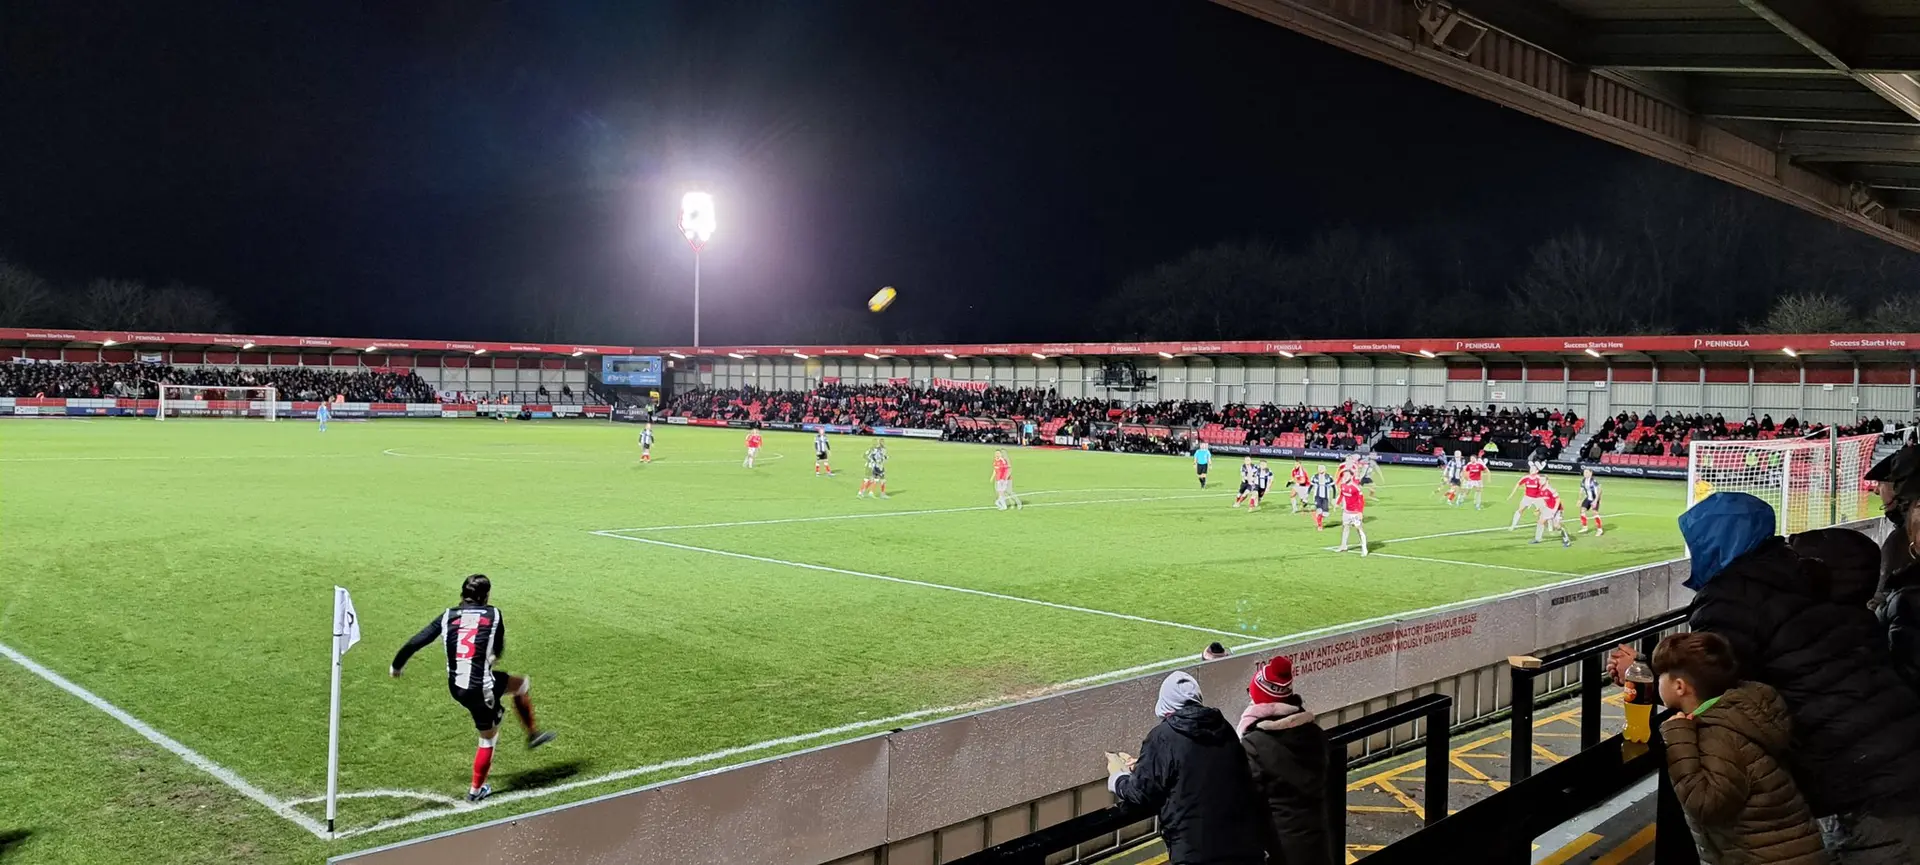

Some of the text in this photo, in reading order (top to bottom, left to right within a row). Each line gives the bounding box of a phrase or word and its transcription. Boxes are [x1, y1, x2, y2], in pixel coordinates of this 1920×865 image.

[456, 628, 478, 658] 3
[1300, 649, 1316, 661] ANY
[1317, 638, 1359, 658] ANTI-SOCIAL
[1361, 636, 1370, 648] OR
[1371, 626, 1424, 645] DISCRIMINATORY
[1424, 618, 1457, 633] BEHAVIOUR
[1458, 613, 1477, 624] PLEASE
[1301, 656, 1342, 674] MATCHDAY
[1343, 648, 1373, 664] HELPLINE
[1374, 637, 1422, 655] ANONYMOUSLY
[1424, 634, 1433, 644] ON
